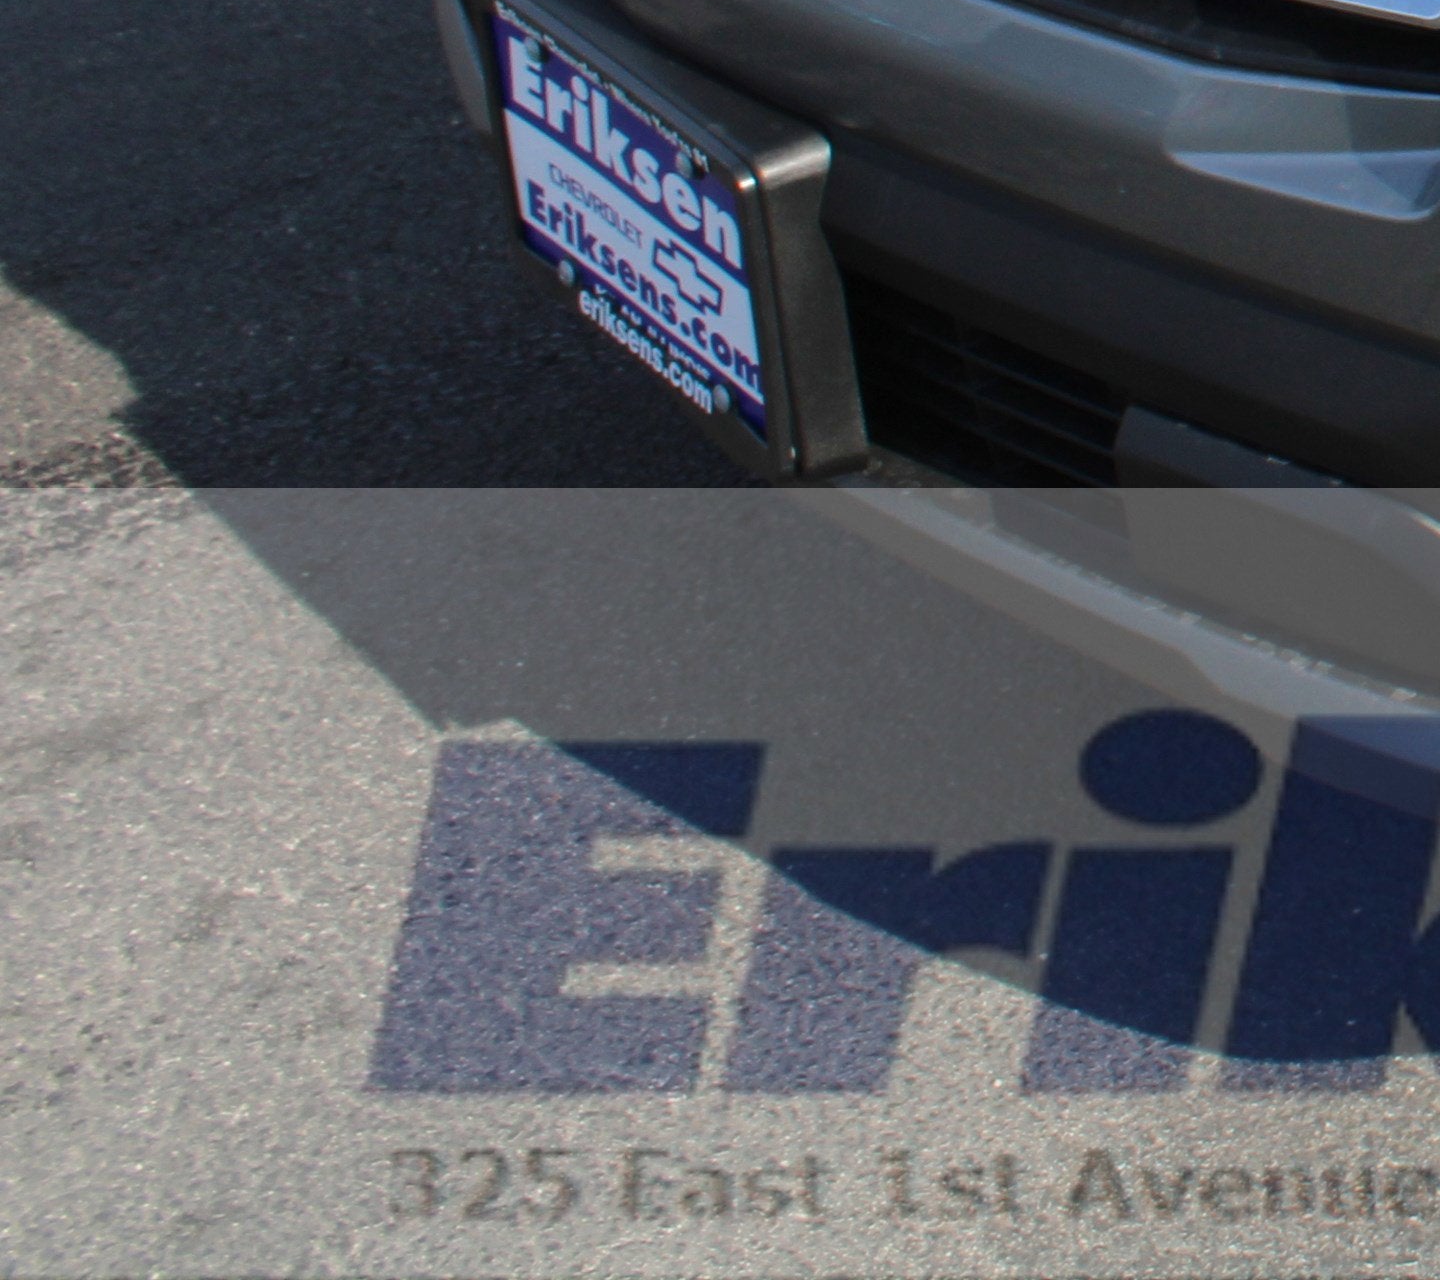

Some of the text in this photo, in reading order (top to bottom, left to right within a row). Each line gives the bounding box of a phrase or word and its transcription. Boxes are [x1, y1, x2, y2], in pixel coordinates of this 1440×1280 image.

[508, 36, 742, 270] Eriksen
[548, 162, 643, 249] CHEVROLET
[526, 178, 760, 391] Eriksens.com
[578, 289, 713, 415] eriksens.com
